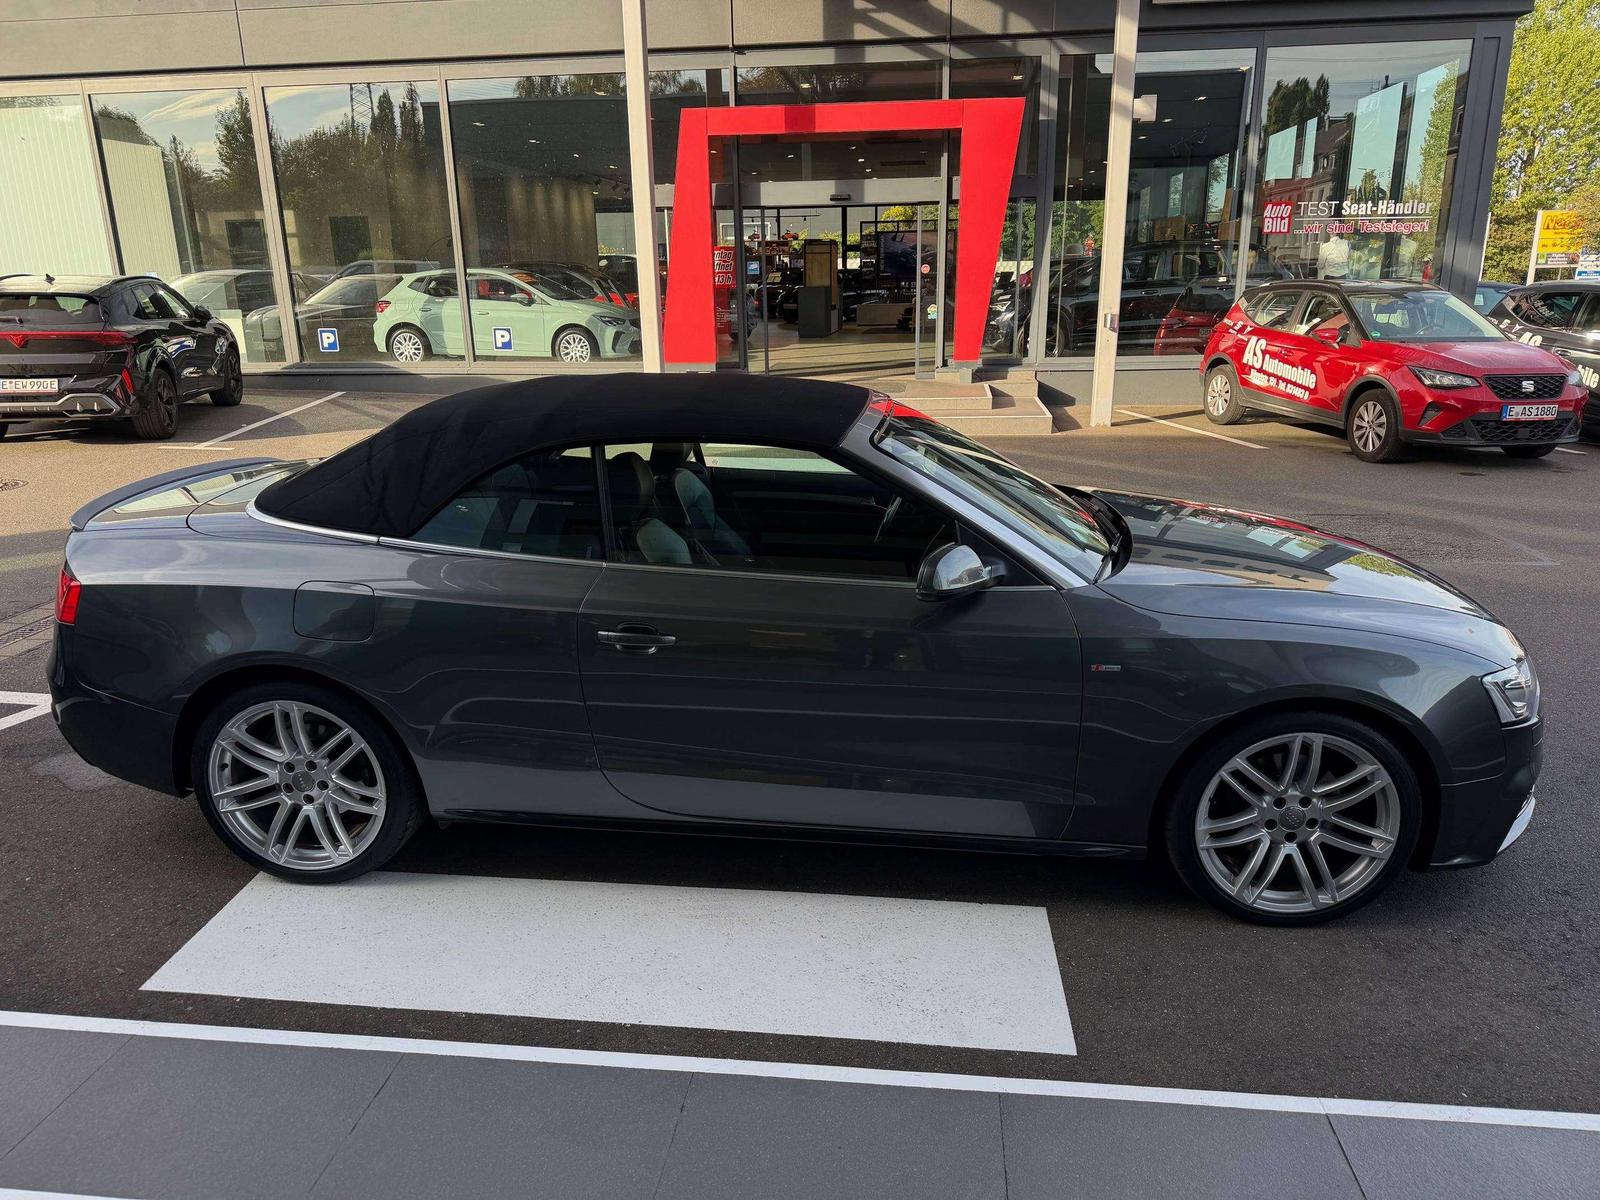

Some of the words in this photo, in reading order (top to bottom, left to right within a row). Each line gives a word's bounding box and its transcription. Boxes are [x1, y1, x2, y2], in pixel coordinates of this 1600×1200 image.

[1263, 203, 1292, 218] Auto
[1298, 201, 1340, 216] TEST
[1341, 200, 1433, 216] Seat-Händler
[1263, 218, 1289, 233] Bild
[1327, 220, 1355, 234] sind
[1358, 219, 1430, 234] Testsieger!
[322, 330, 336, 348] P
[495, 330, 511, 348] P
[1242, 335, 1267, 369] AS
[1262, 353, 1317, 389] Automobile
